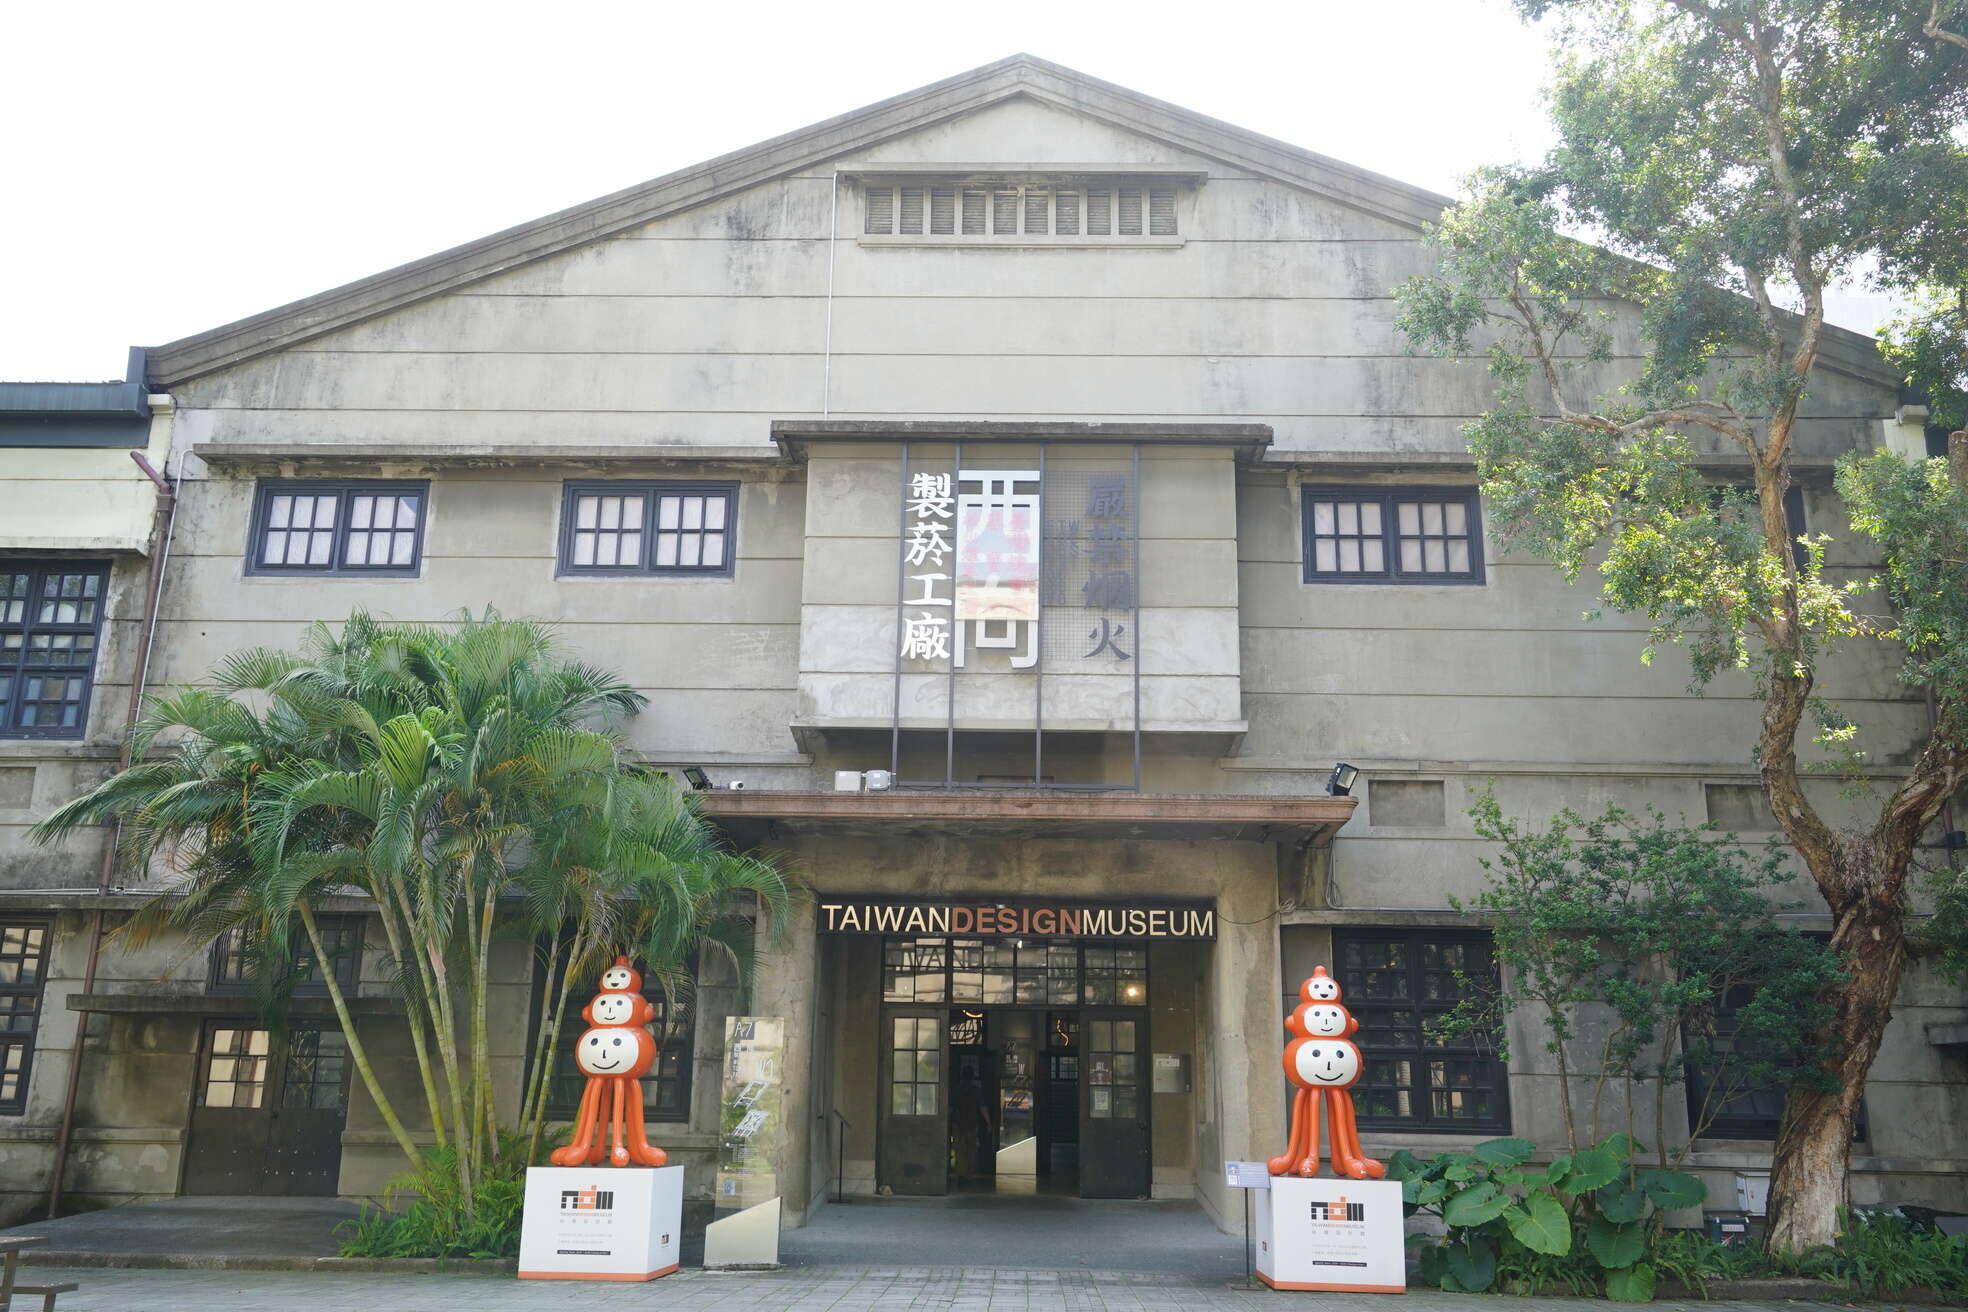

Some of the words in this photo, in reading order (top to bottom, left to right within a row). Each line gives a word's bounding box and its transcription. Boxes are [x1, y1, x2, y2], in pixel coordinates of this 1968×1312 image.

[901, 472, 955, 660] 製菸工廠
[821, 903, 1214, 938] TAIWANDESIGNMUSEUM
